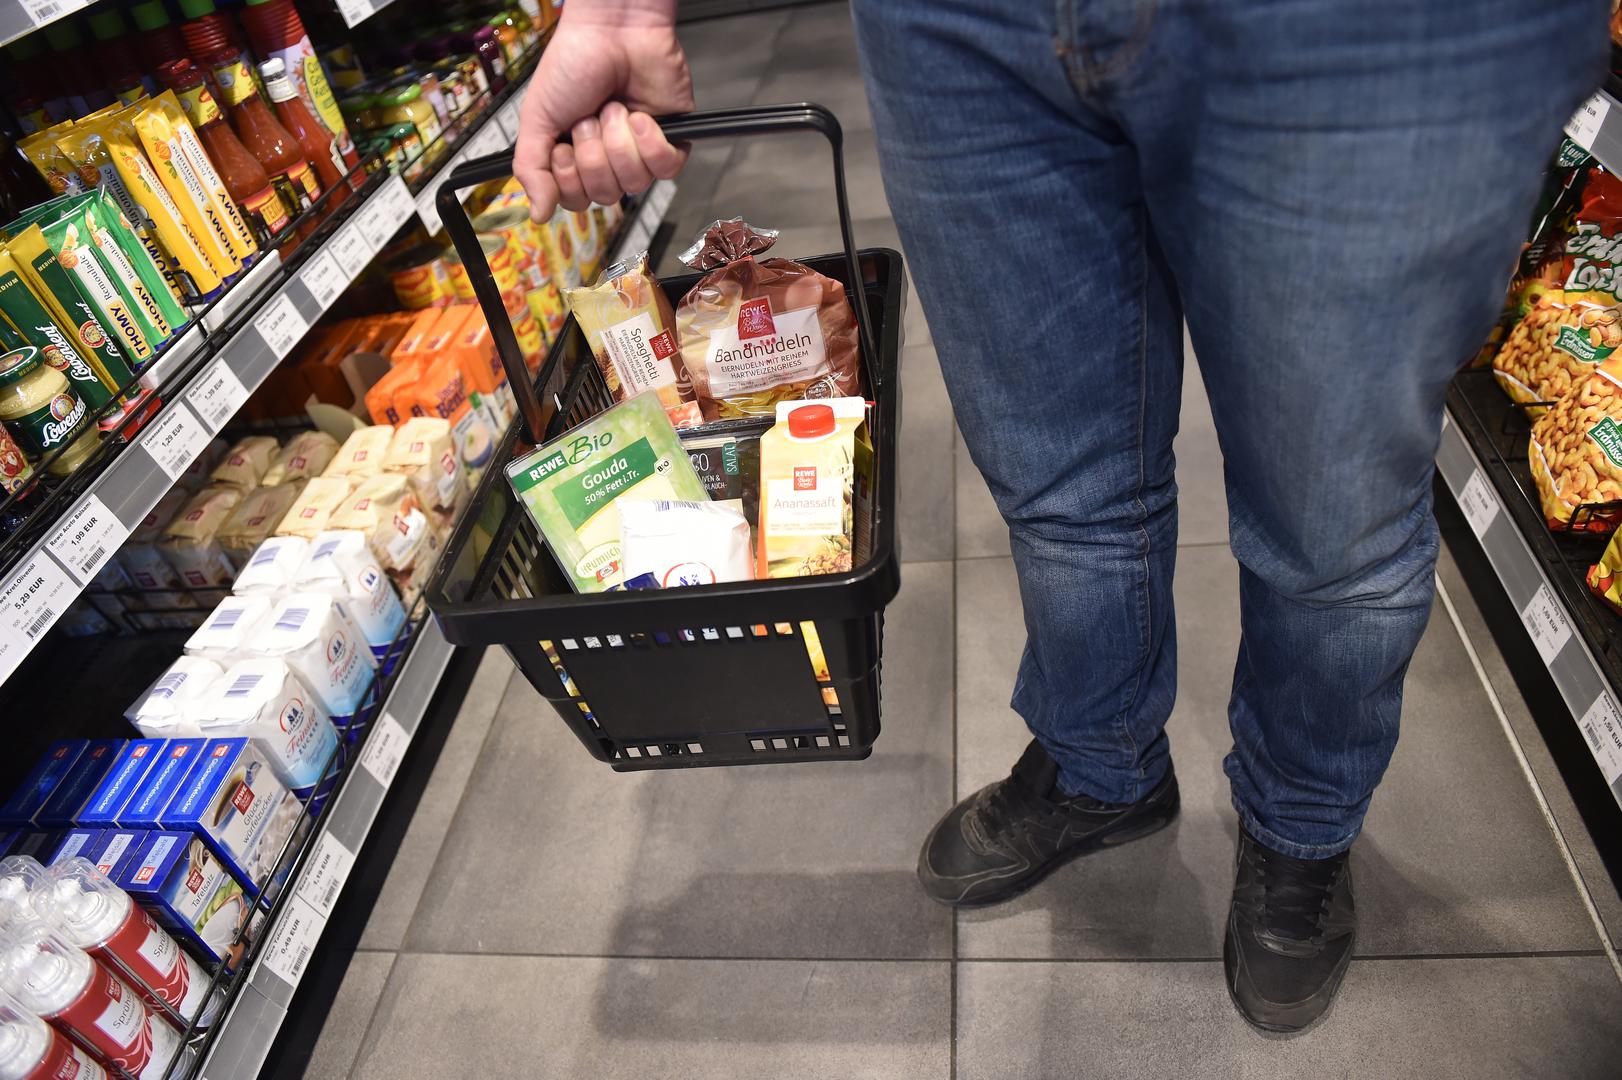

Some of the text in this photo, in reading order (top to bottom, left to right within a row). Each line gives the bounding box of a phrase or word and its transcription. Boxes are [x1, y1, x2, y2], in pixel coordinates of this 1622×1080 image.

[104, 169, 143, 229] Mayonnaise
[218, 193, 252, 246] THOMY
[206, 208, 240, 266] THOMY
[80, 255, 113, 301] Remoulade
[135, 285, 169, 337] THOMY
[110, 306, 147, 356] THOMY
[661, 333, 674, 354] REWE
[35, 321, 97, 383] Löwensenf
[631, 327, 660, 380] Spaghetti
[715, 333, 812, 363] Bandnudeln
[721, 350, 809, 373] EIERNUDELN MIT REINEM
[730, 360, 802, 379] HARTWEIZENGRIESS
[161, 423, 185, 448] 1,29 EUR
[529, 432, 613, 482] REWE Bio
[582, 457, 628, 490] Gouda
[585, 470, 640, 505] 50% Fett i.Tr.
[774, 496, 836, 509] Ananassaft
[49, 531, 64, 548] Rewe
[62, 517, 77, 534] Aceto
[70, 516, 98, 547] 1,99 EUR
[14, 576, 46, 611] 5,29 EUR
[1549, 618, 1559, 635] EUR
[1611, 732, 1622, 750] EUR
[234, 786, 248, 806] REWE
[243, 795, 264, 826] Glücks-
[243, 791, 274, 845] würfelzucker
[187, 871, 199, 890] REWE
[313, 853, 331, 886] 1,19 EUR
[192, 873, 215, 908] Tafelsalz
[280, 918, 300, 955] 0,49 EUR
